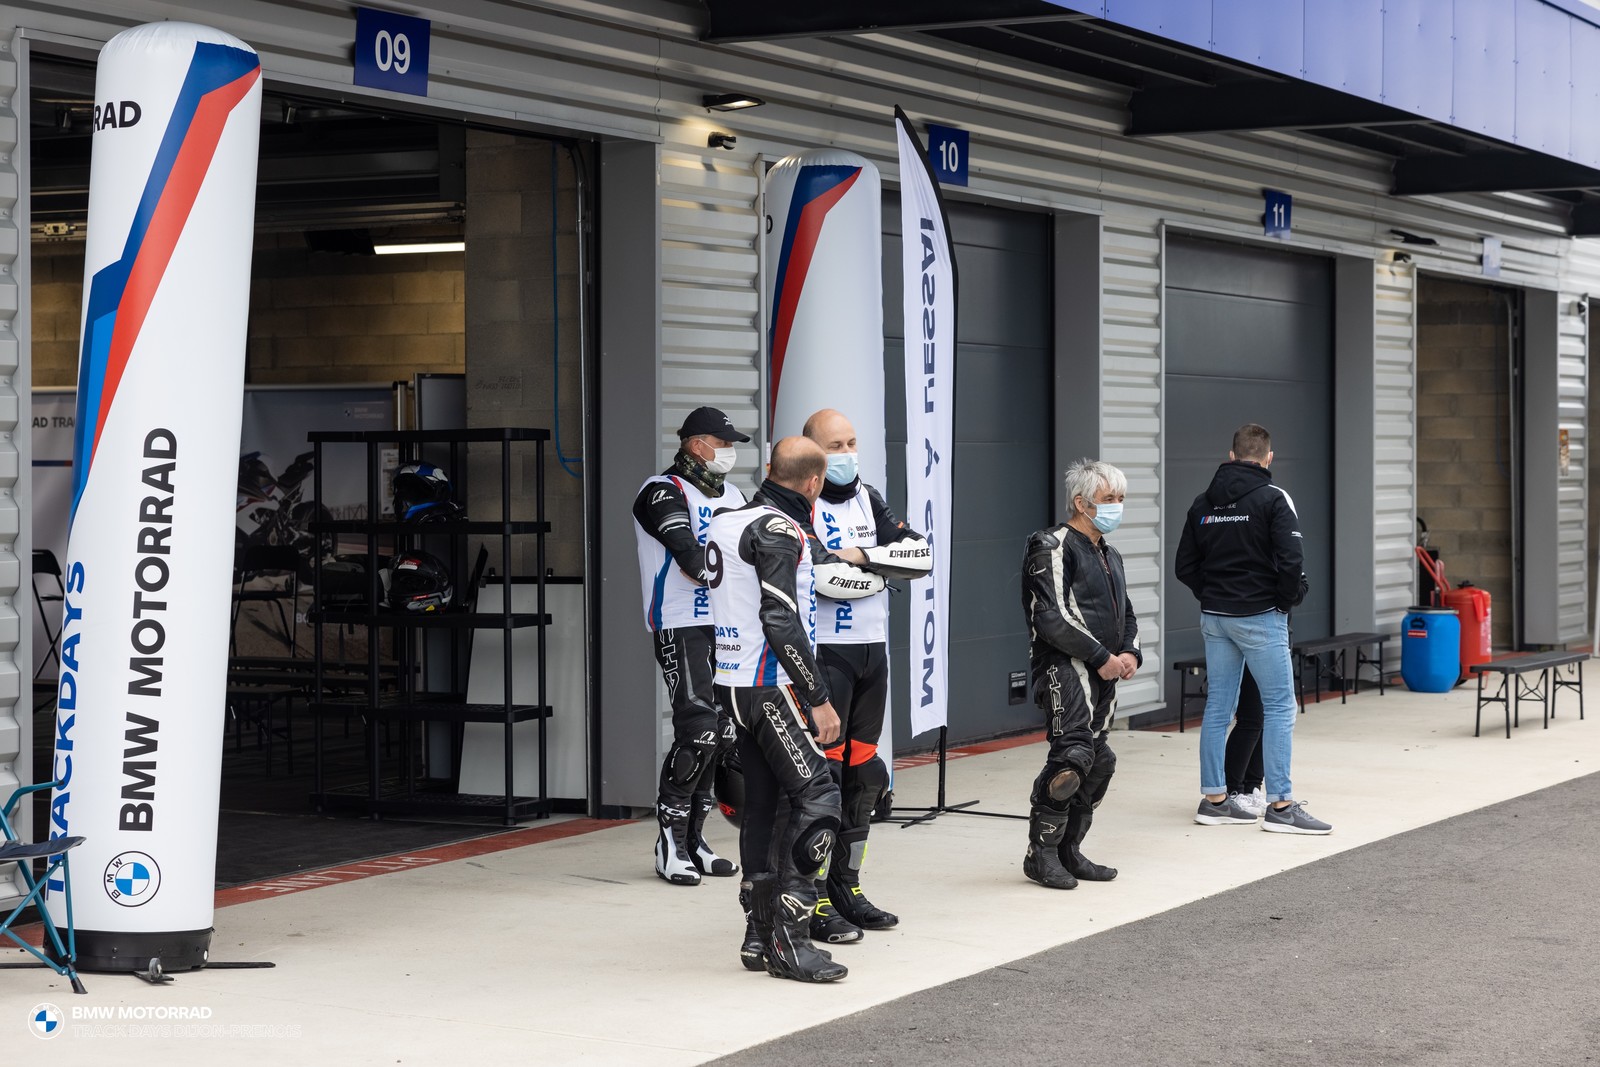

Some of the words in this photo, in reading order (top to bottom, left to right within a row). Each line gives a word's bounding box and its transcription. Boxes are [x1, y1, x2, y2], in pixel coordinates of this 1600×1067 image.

[374, 29, 411, 75] 09
[938, 140, 959, 173] 10
[1272, 202, 1285, 228] 11
[1214, 514, 1250, 524] Motorsport
[127, 427, 178, 697] MOTORRAD
[706, 541, 724, 589] 9
[118, 711, 160, 832] BMW
[660, 802, 690, 817] TCX
